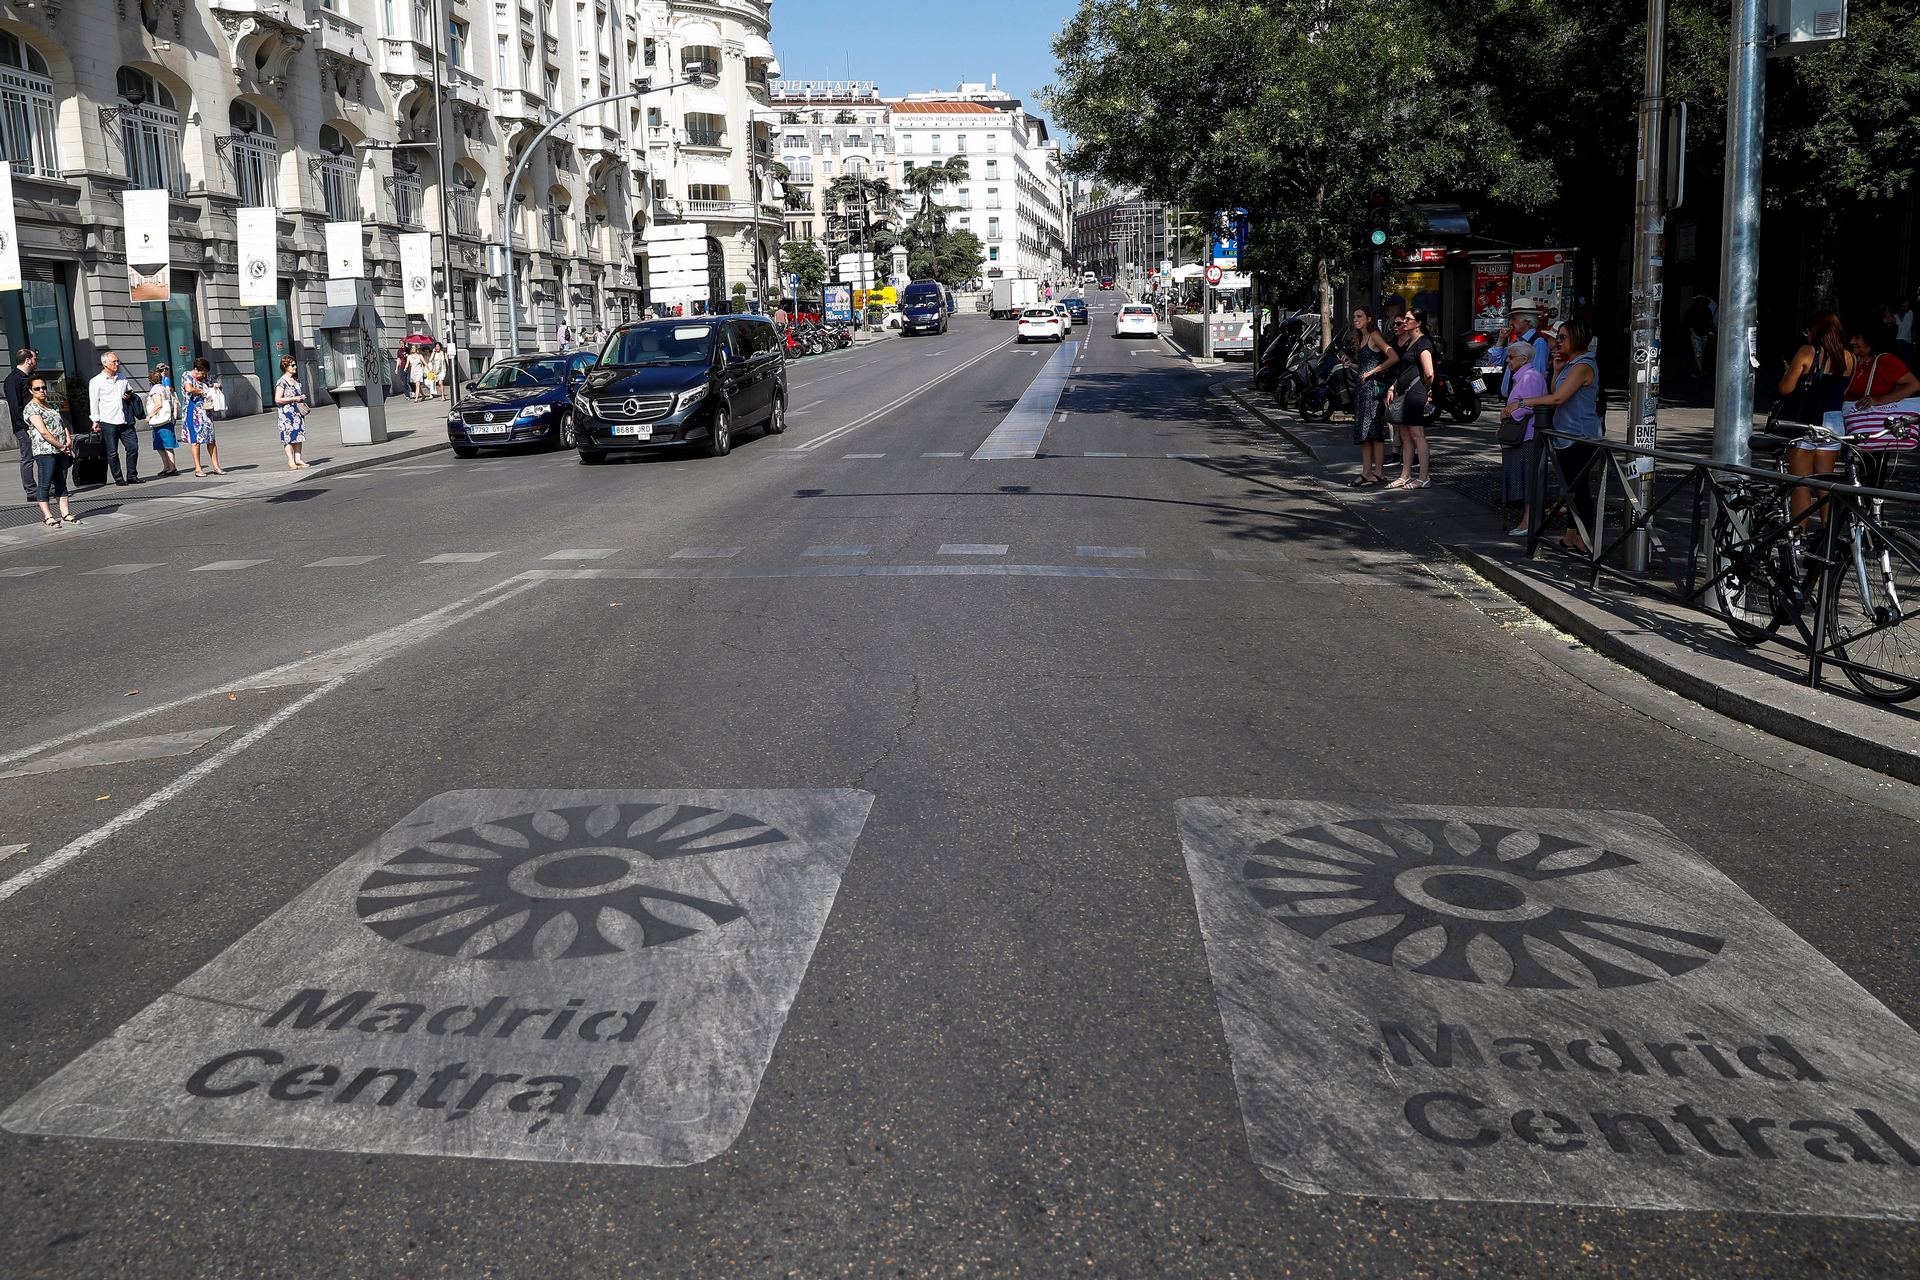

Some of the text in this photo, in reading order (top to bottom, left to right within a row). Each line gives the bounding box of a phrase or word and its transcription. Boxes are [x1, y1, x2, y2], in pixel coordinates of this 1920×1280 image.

[770, 81, 875, 90] HOTEL VILLA REAL
[616, 426, 634, 434] 8688
[1636, 426, 1654, 437] BNE
[261, 988, 657, 1043] Madrid
[1378, 1020, 1828, 1082] Madrid
[185, 1048, 629, 1118] Central
[1403, 1090, 1920, 1167] Central
